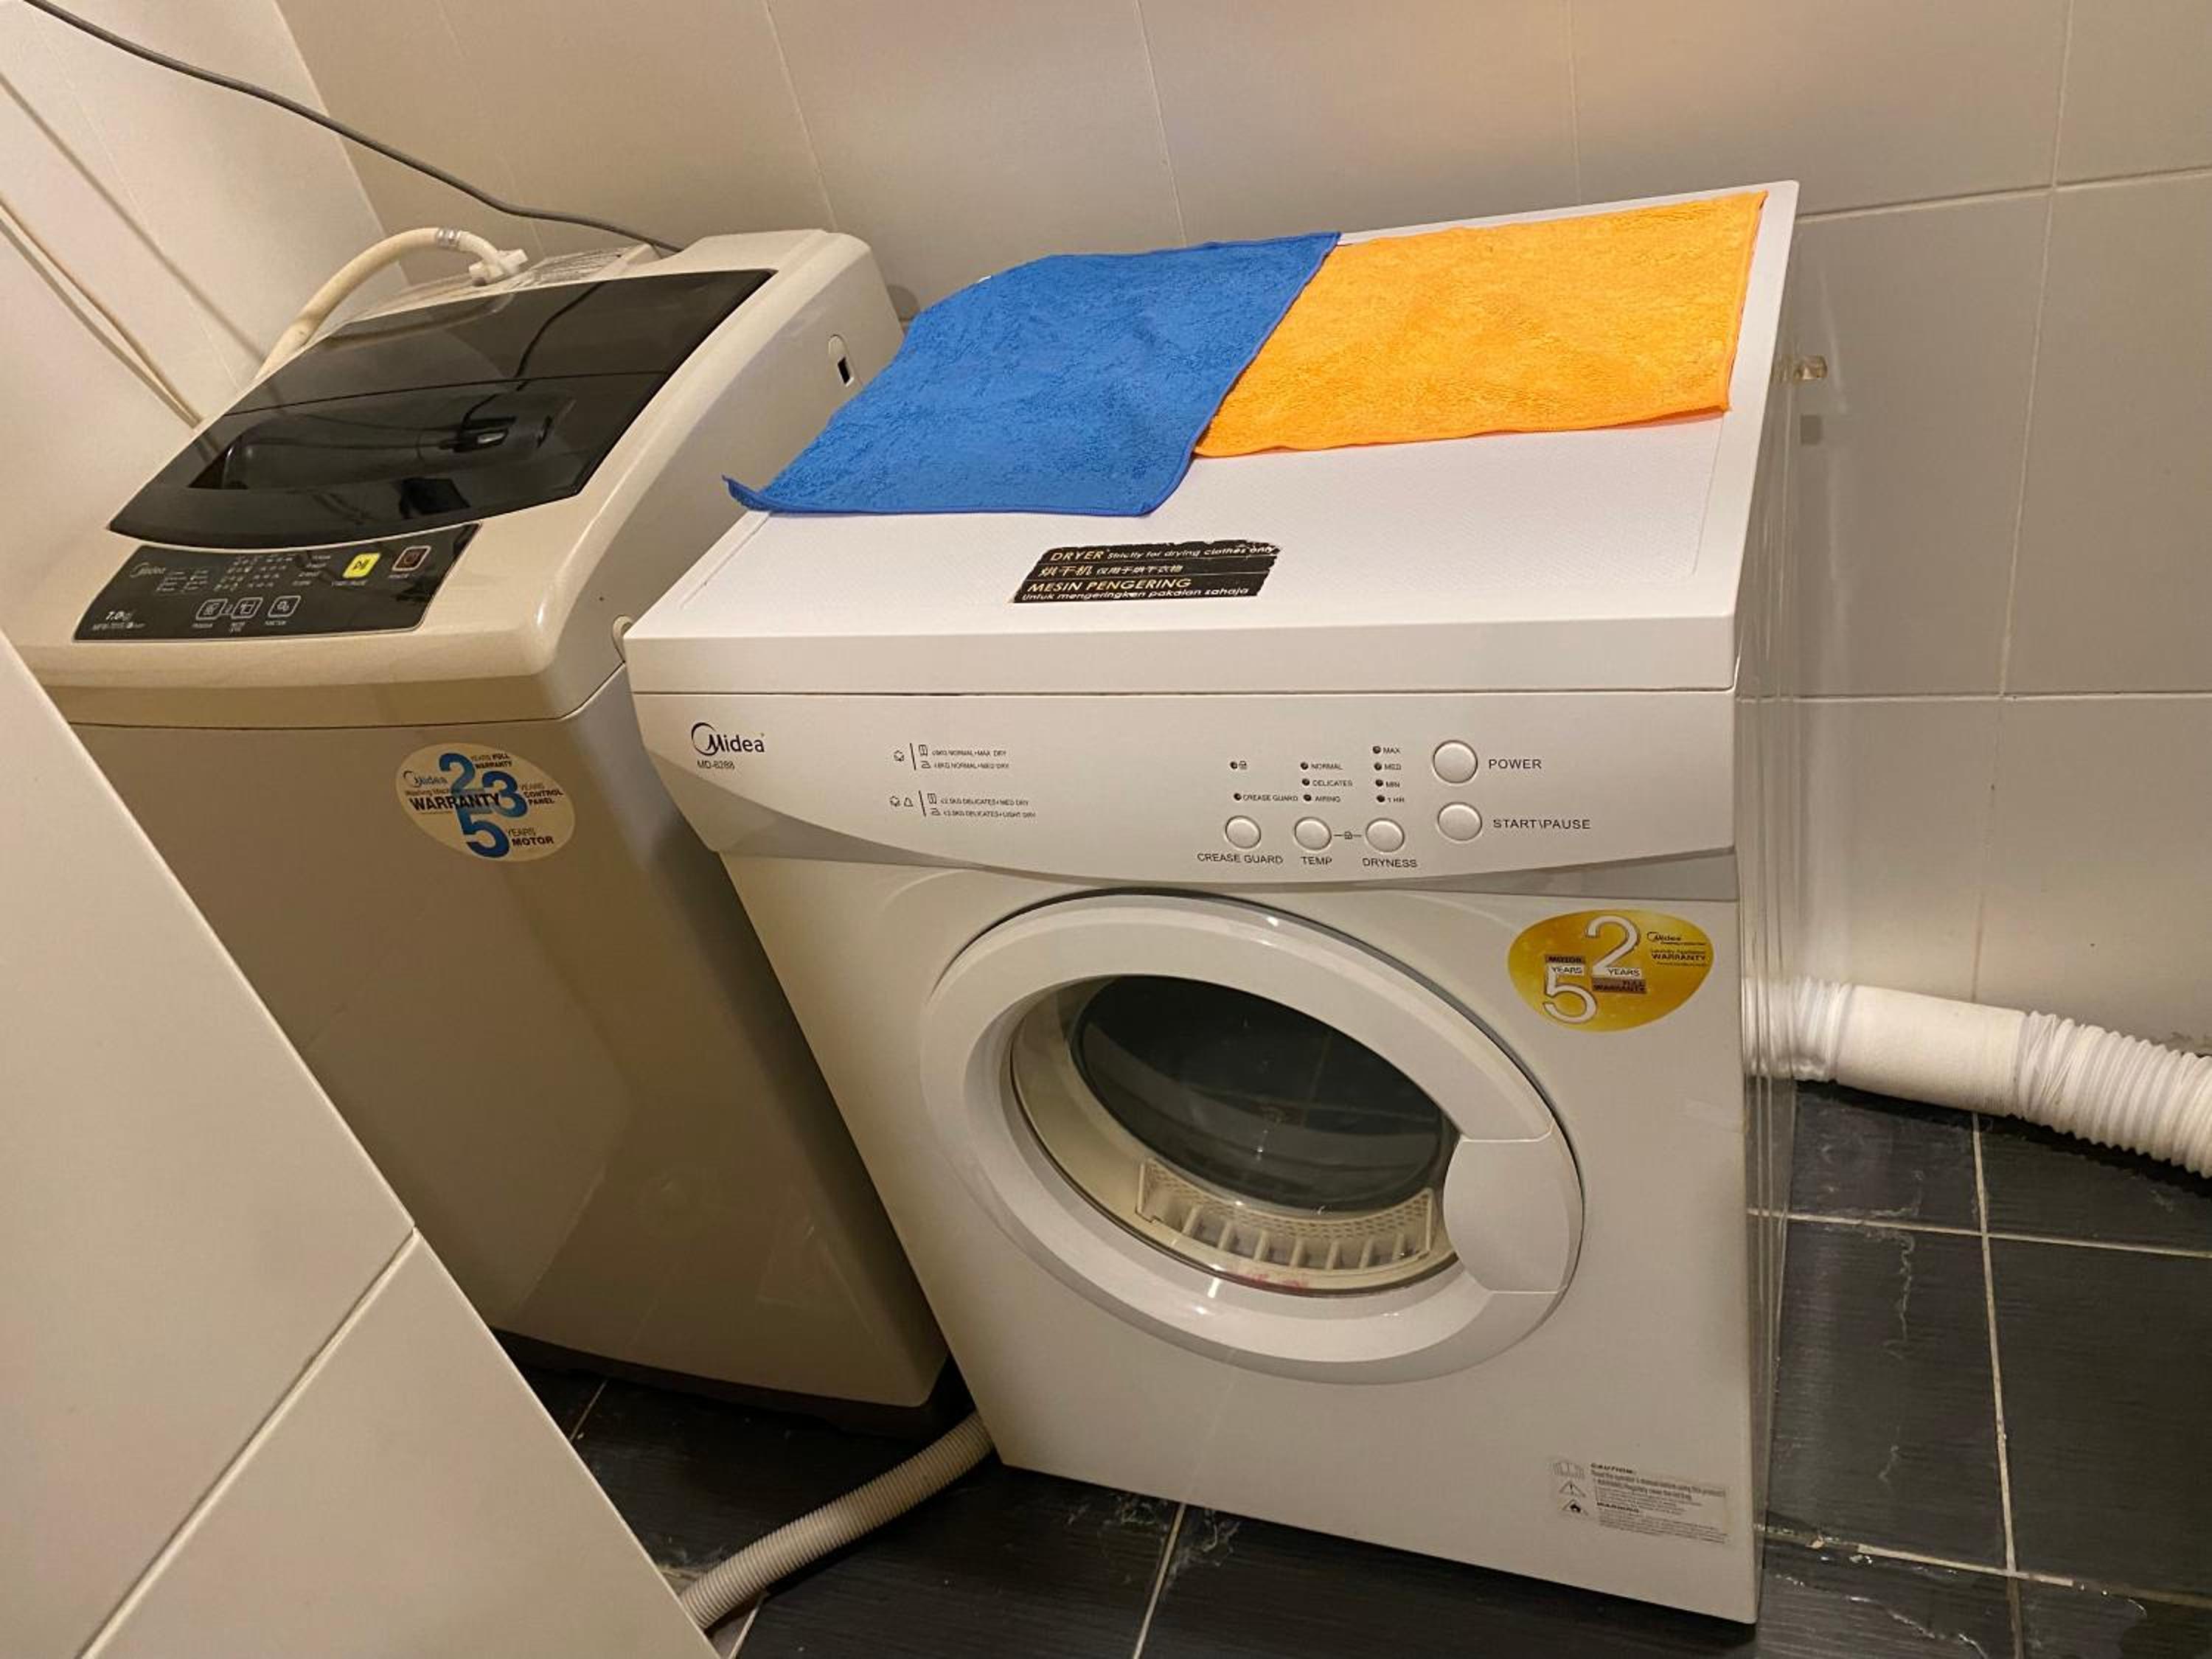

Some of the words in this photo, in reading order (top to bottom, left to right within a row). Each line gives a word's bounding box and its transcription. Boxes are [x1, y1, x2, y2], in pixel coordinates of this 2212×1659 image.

[1049, 550, 1104, 562] DRYER
[1107, 551, 1144, 560] Strictly
[1164, 549, 1201, 557] drying
[1203, 546, 1247, 555] clothes
[1037, 565, 1093, 577] 烘干机
[1027, 581, 1083, 592] MESIN
[1085, 578, 1192, 591] PENGERING
[1205, 587, 1249, 597] sahaja
[691, 722, 765, 757] Midea
[1382, 746, 1401, 754] MAX
[1310, 762, 1343, 771] NORMAL
[1383, 762, 1402, 771] MED
[1488, 758, 1542, 770] POWER
[439, 753, 481, 795] 2
[1312, 779, 1353, 787] DELICATES
[481, 770, 529, 818] 3
[523, 789, 564, 799] CONTROL
[1242, 793, 1272, 801] CREASE
[1273, 793, 1298, 802] GUARD
[408, 793, 501, 812] WARRANTY
[528, 797, 555, 806] PANEL
[456, 808, 510, 858] 5
[507, 827, 537, 838] YEARS
[512, 835, 554, 847] MOTOR
[1197, 852, 1242, 864] CREASE
[1244, 854, 1284, 866] GUARD
[1300, 856, 1333, 866] TEMP
[1362, 857, 1418, 869] DRYNESS
[1585, 915, 1643, 978] 2
[1651, 953, 1706, 961] WARRANTY
[1551, 966, 1583, 975] YEARS
[1607, 968, 1641, 977] YEARS
[1543, 961, 1598, 1025] 5
